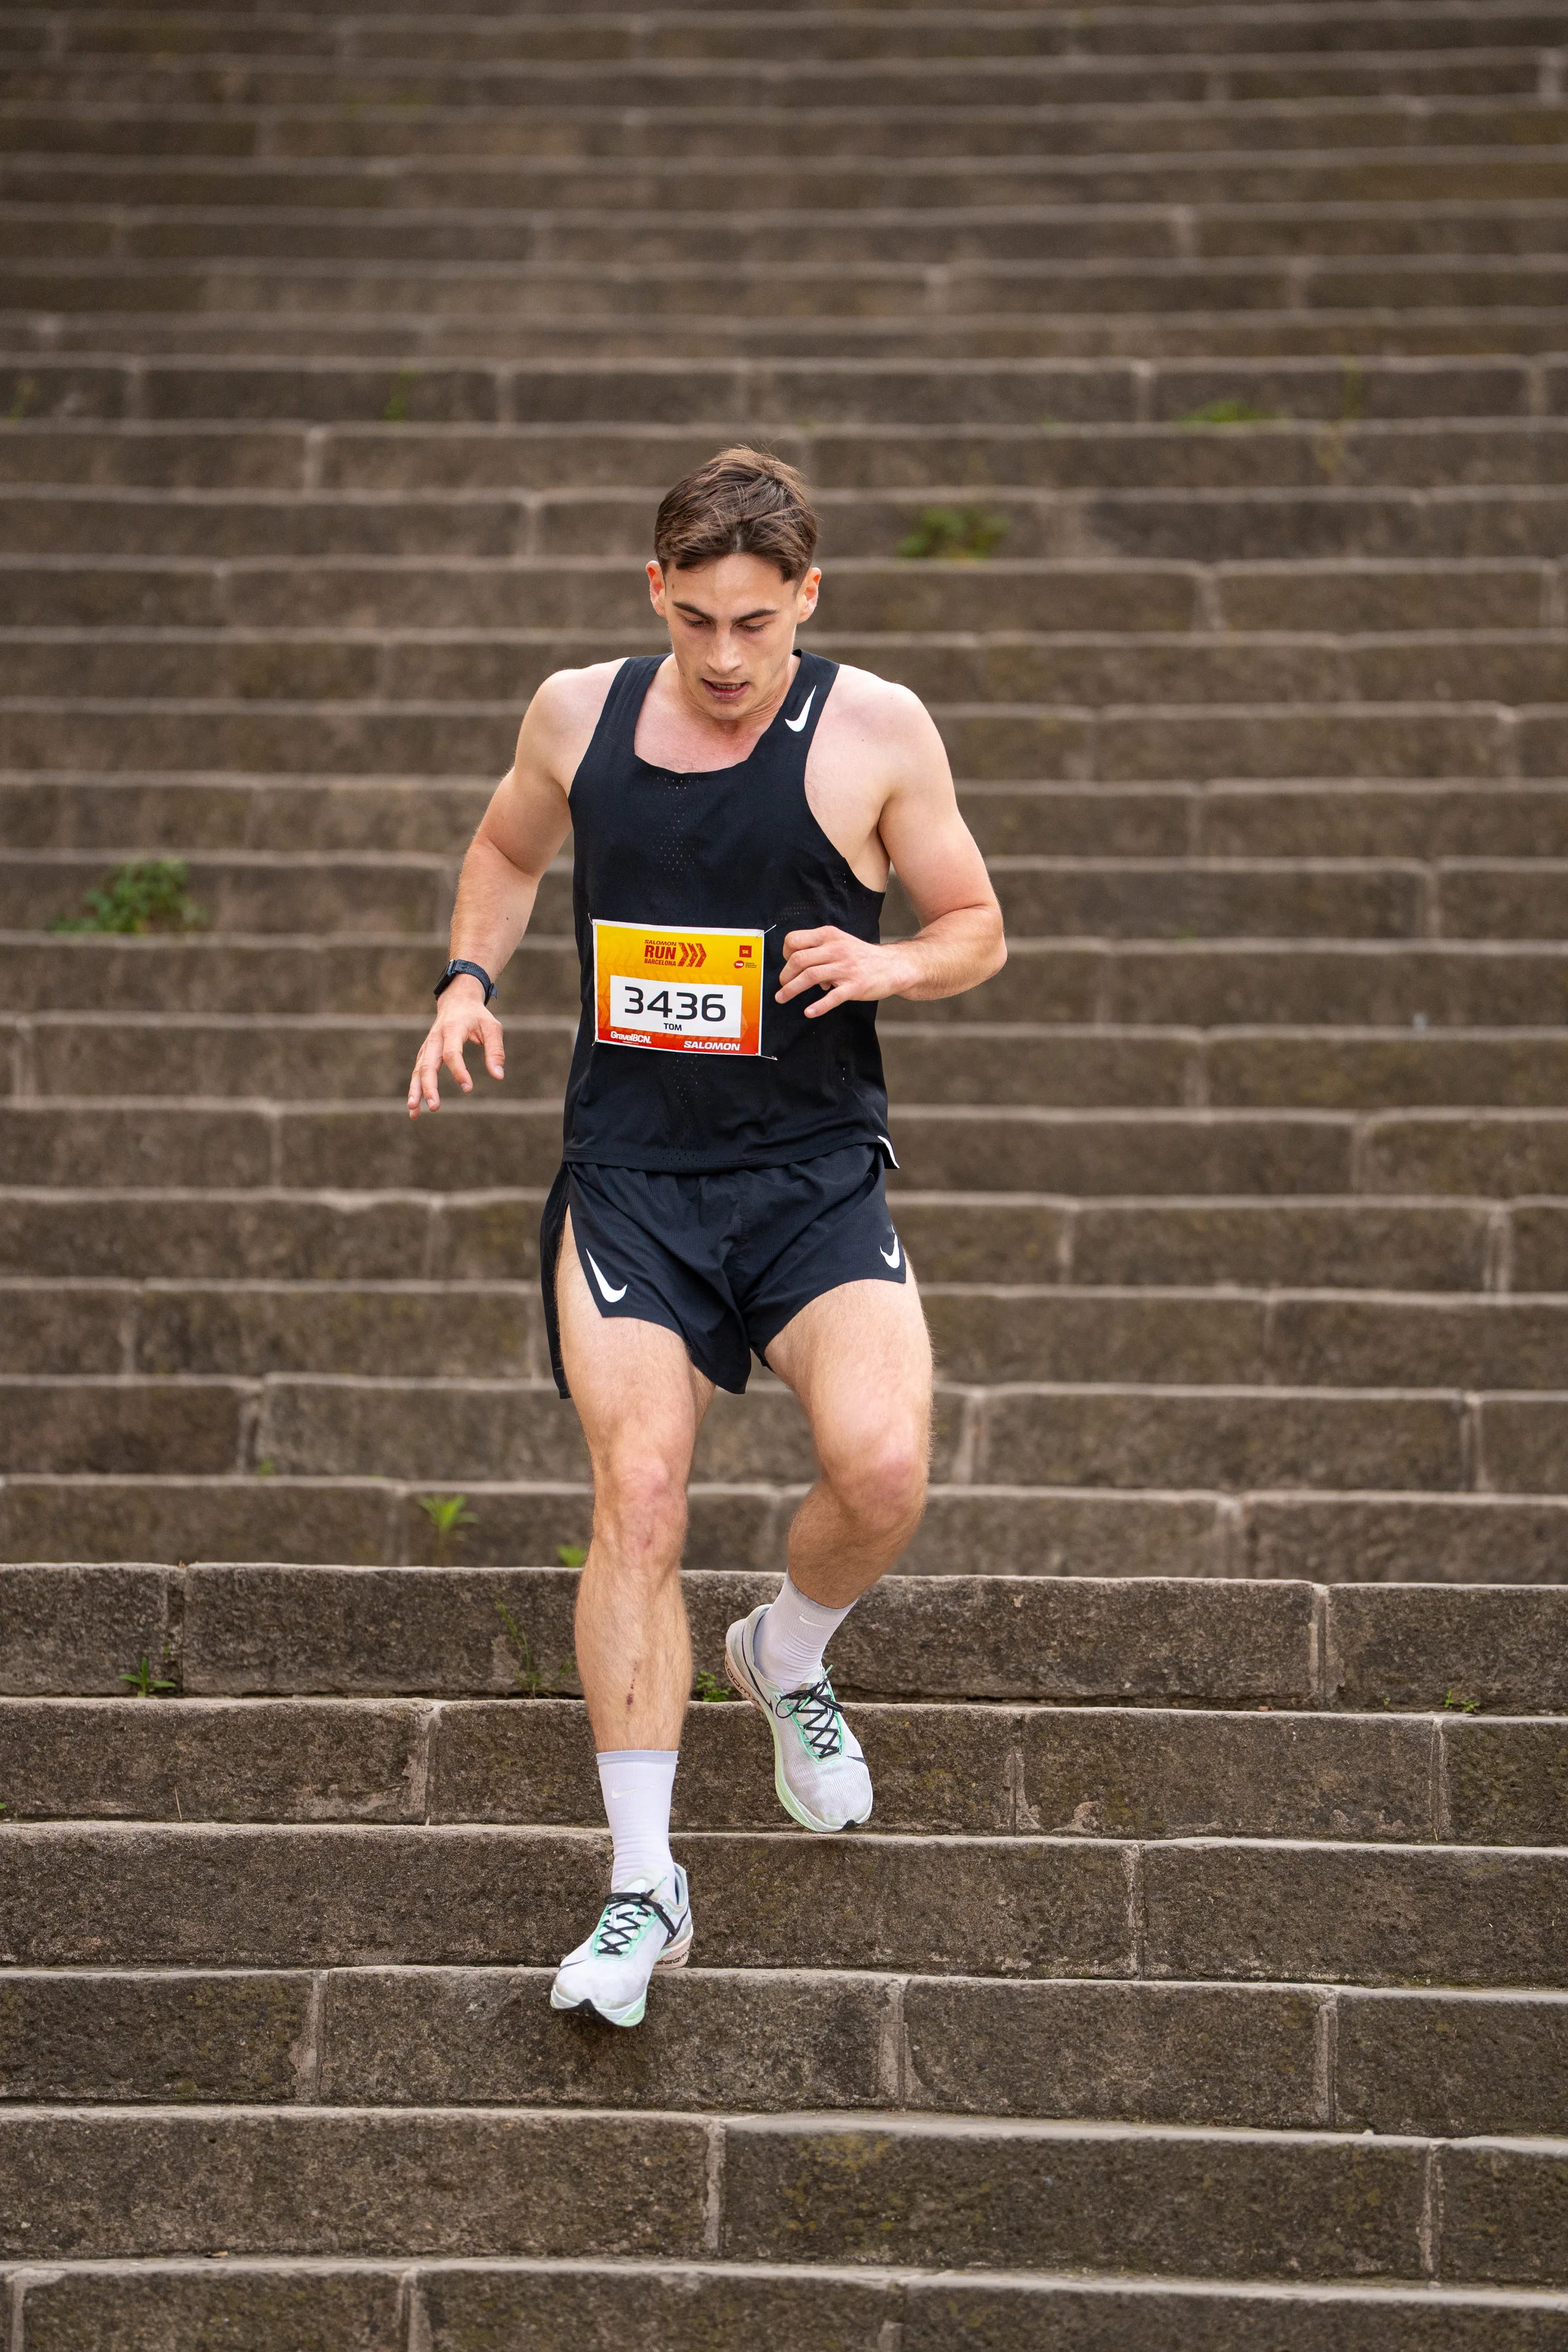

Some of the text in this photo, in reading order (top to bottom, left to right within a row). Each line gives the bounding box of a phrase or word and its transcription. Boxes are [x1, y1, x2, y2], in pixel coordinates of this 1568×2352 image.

[644, 945, 676, 960] RUN
[625, 986, 726, 1022] 3436
[683, 1040, 740, 1051] SALOMON
